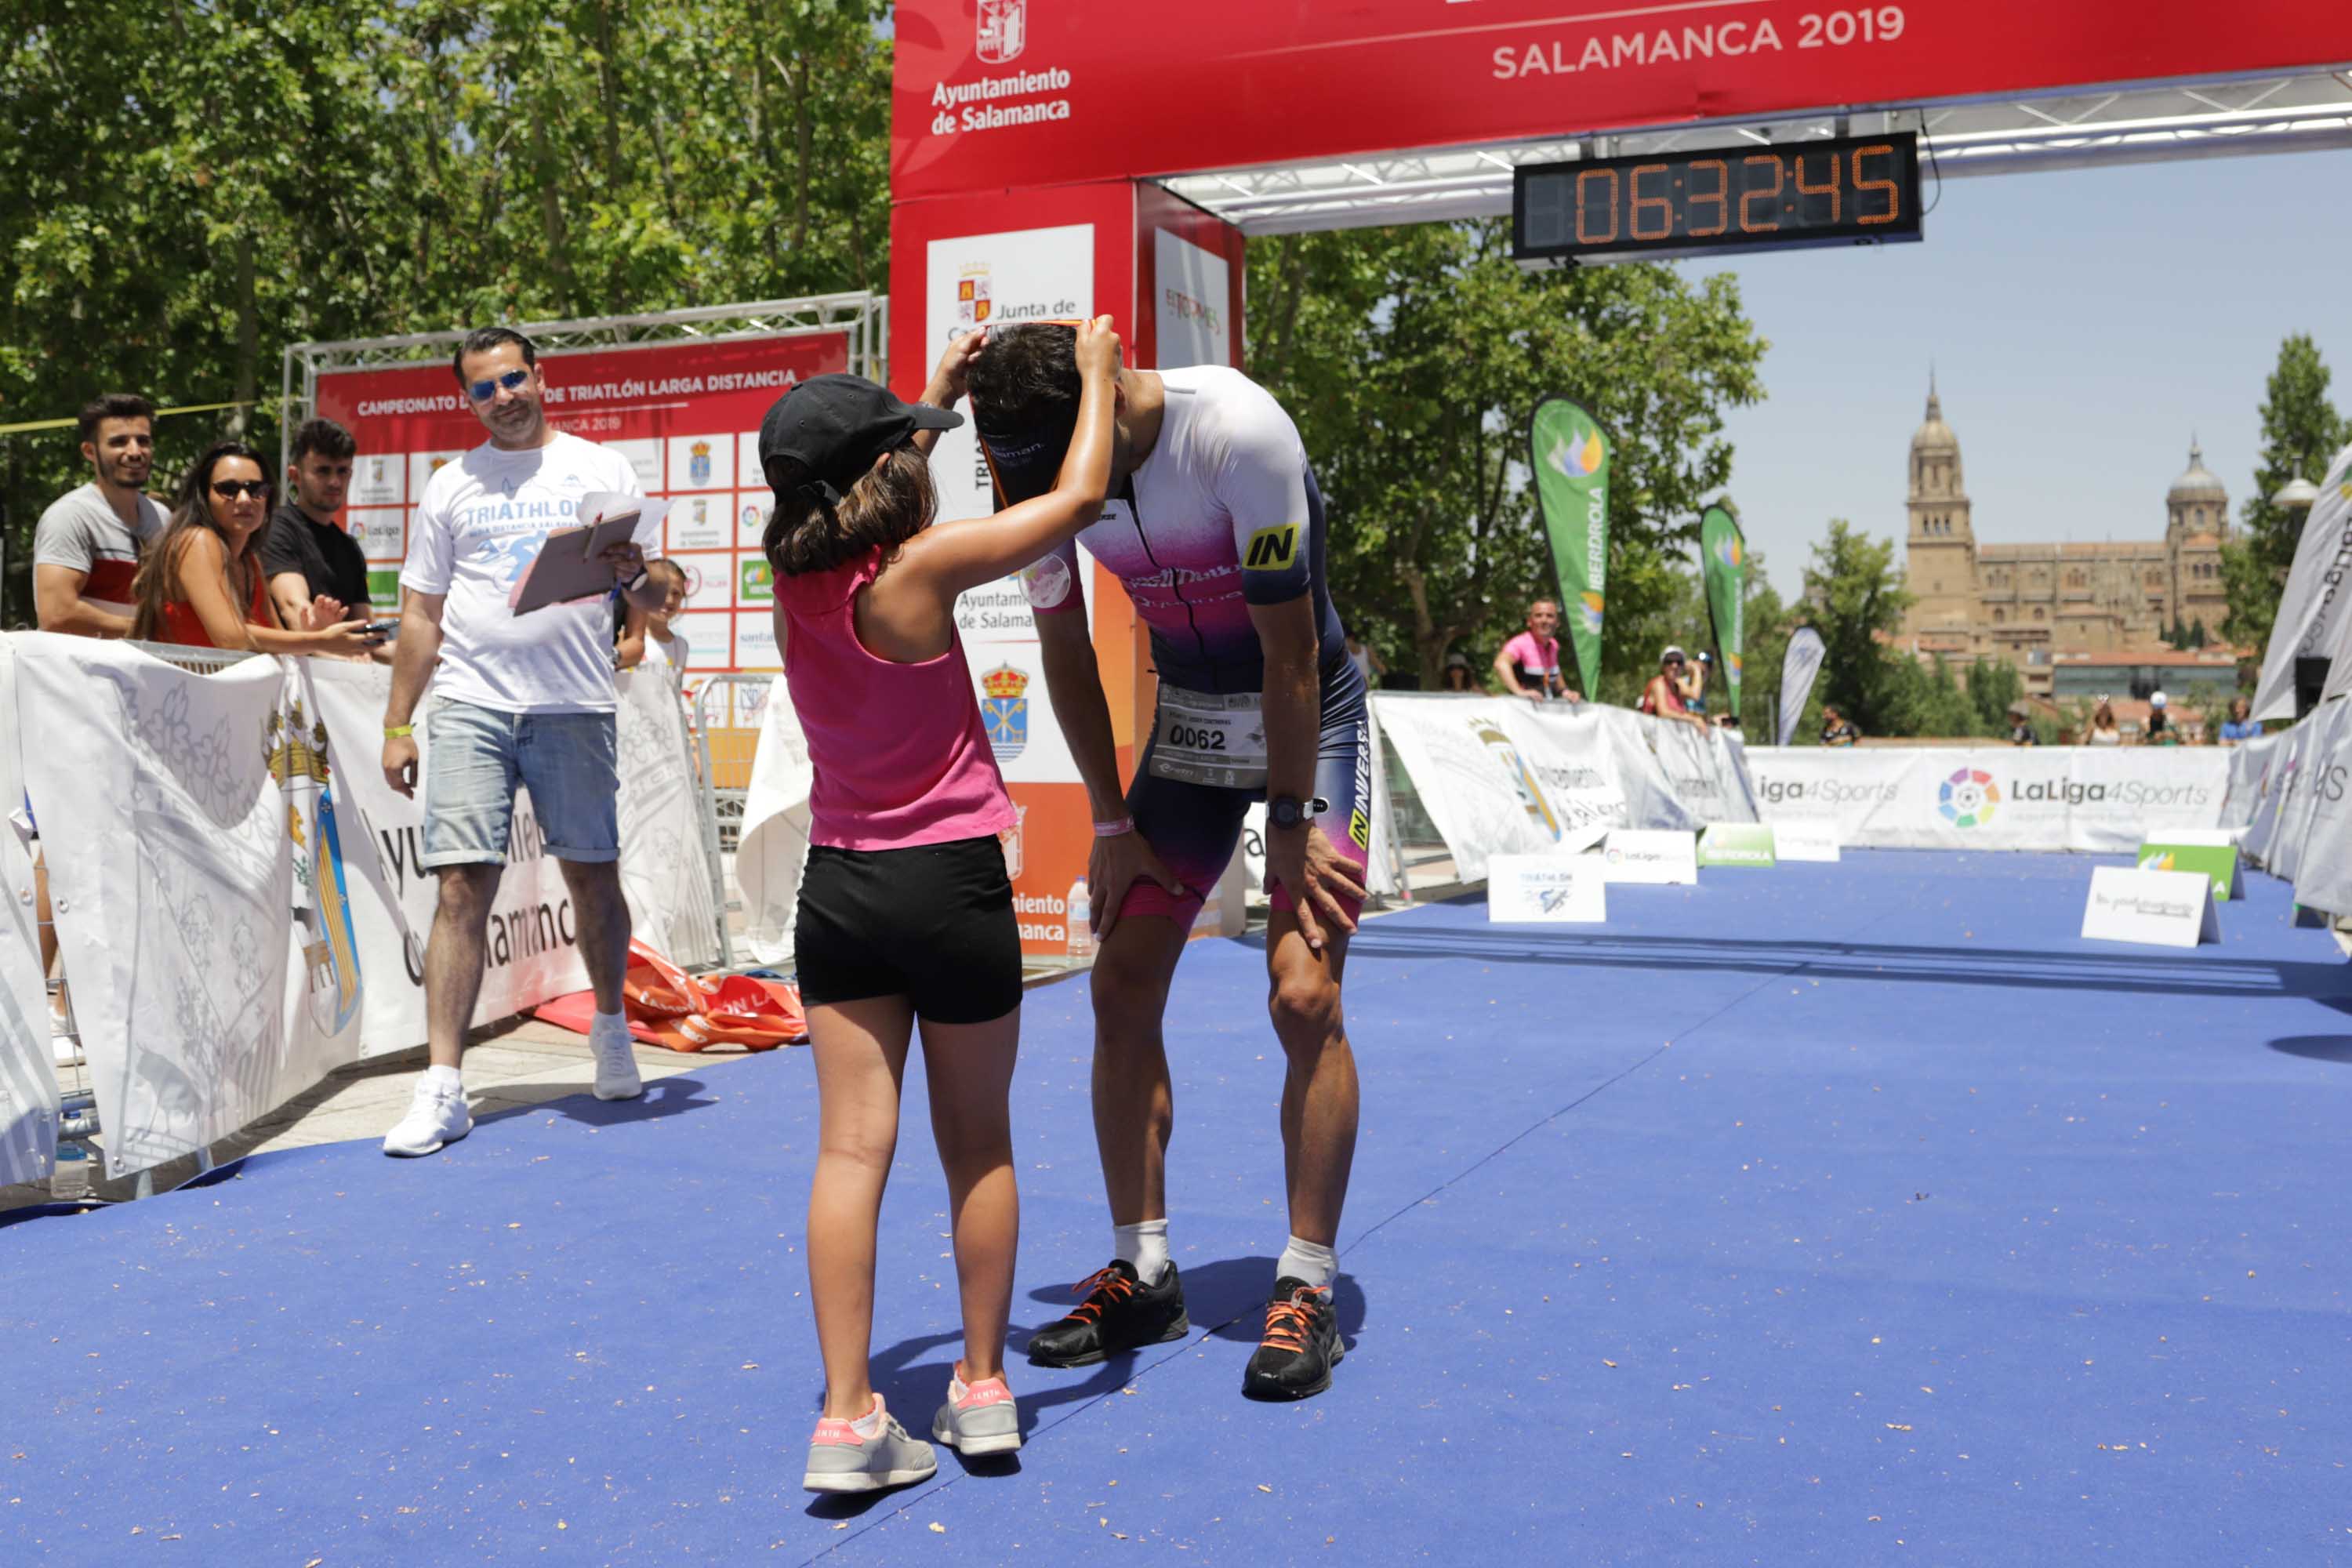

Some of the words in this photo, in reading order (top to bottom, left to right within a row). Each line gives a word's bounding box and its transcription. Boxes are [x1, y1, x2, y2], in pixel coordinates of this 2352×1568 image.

[1492, 19, 1783, 79] SALAMANCA
[1798, 5, 1905, 49] 2019
[931, 67, 1072, 110] Ayuntamiento
[931, 111, 957, 135] de
[961, 100, 1071, 132] Salamanca
[1576, 144, 1898, 245] 06:32:45
[997, 302, 1046, 320] Junta
[1051, 300, 1076, 314] de
[544, 387, 565, 404] DE
[568, 379, 645, 401] TRIATLÓN
[648, 376, 703, 396] LARGA
[708, 369, 797, 391] DISTANCIA
[357, 394, 457, 417] CAMPEONATO
[592, 416, 622, 431] 2019
[1247, 527, 1294, 566] IN
[1588, 487, 1606, 590] IBERDROLA
[959, 614, 976, 629] de
[1169, 724, 1226, 751] 0062
[2012, 775, 2209, 808] LaLiga4Sports
[1352, 815, 1367, 848] IN
